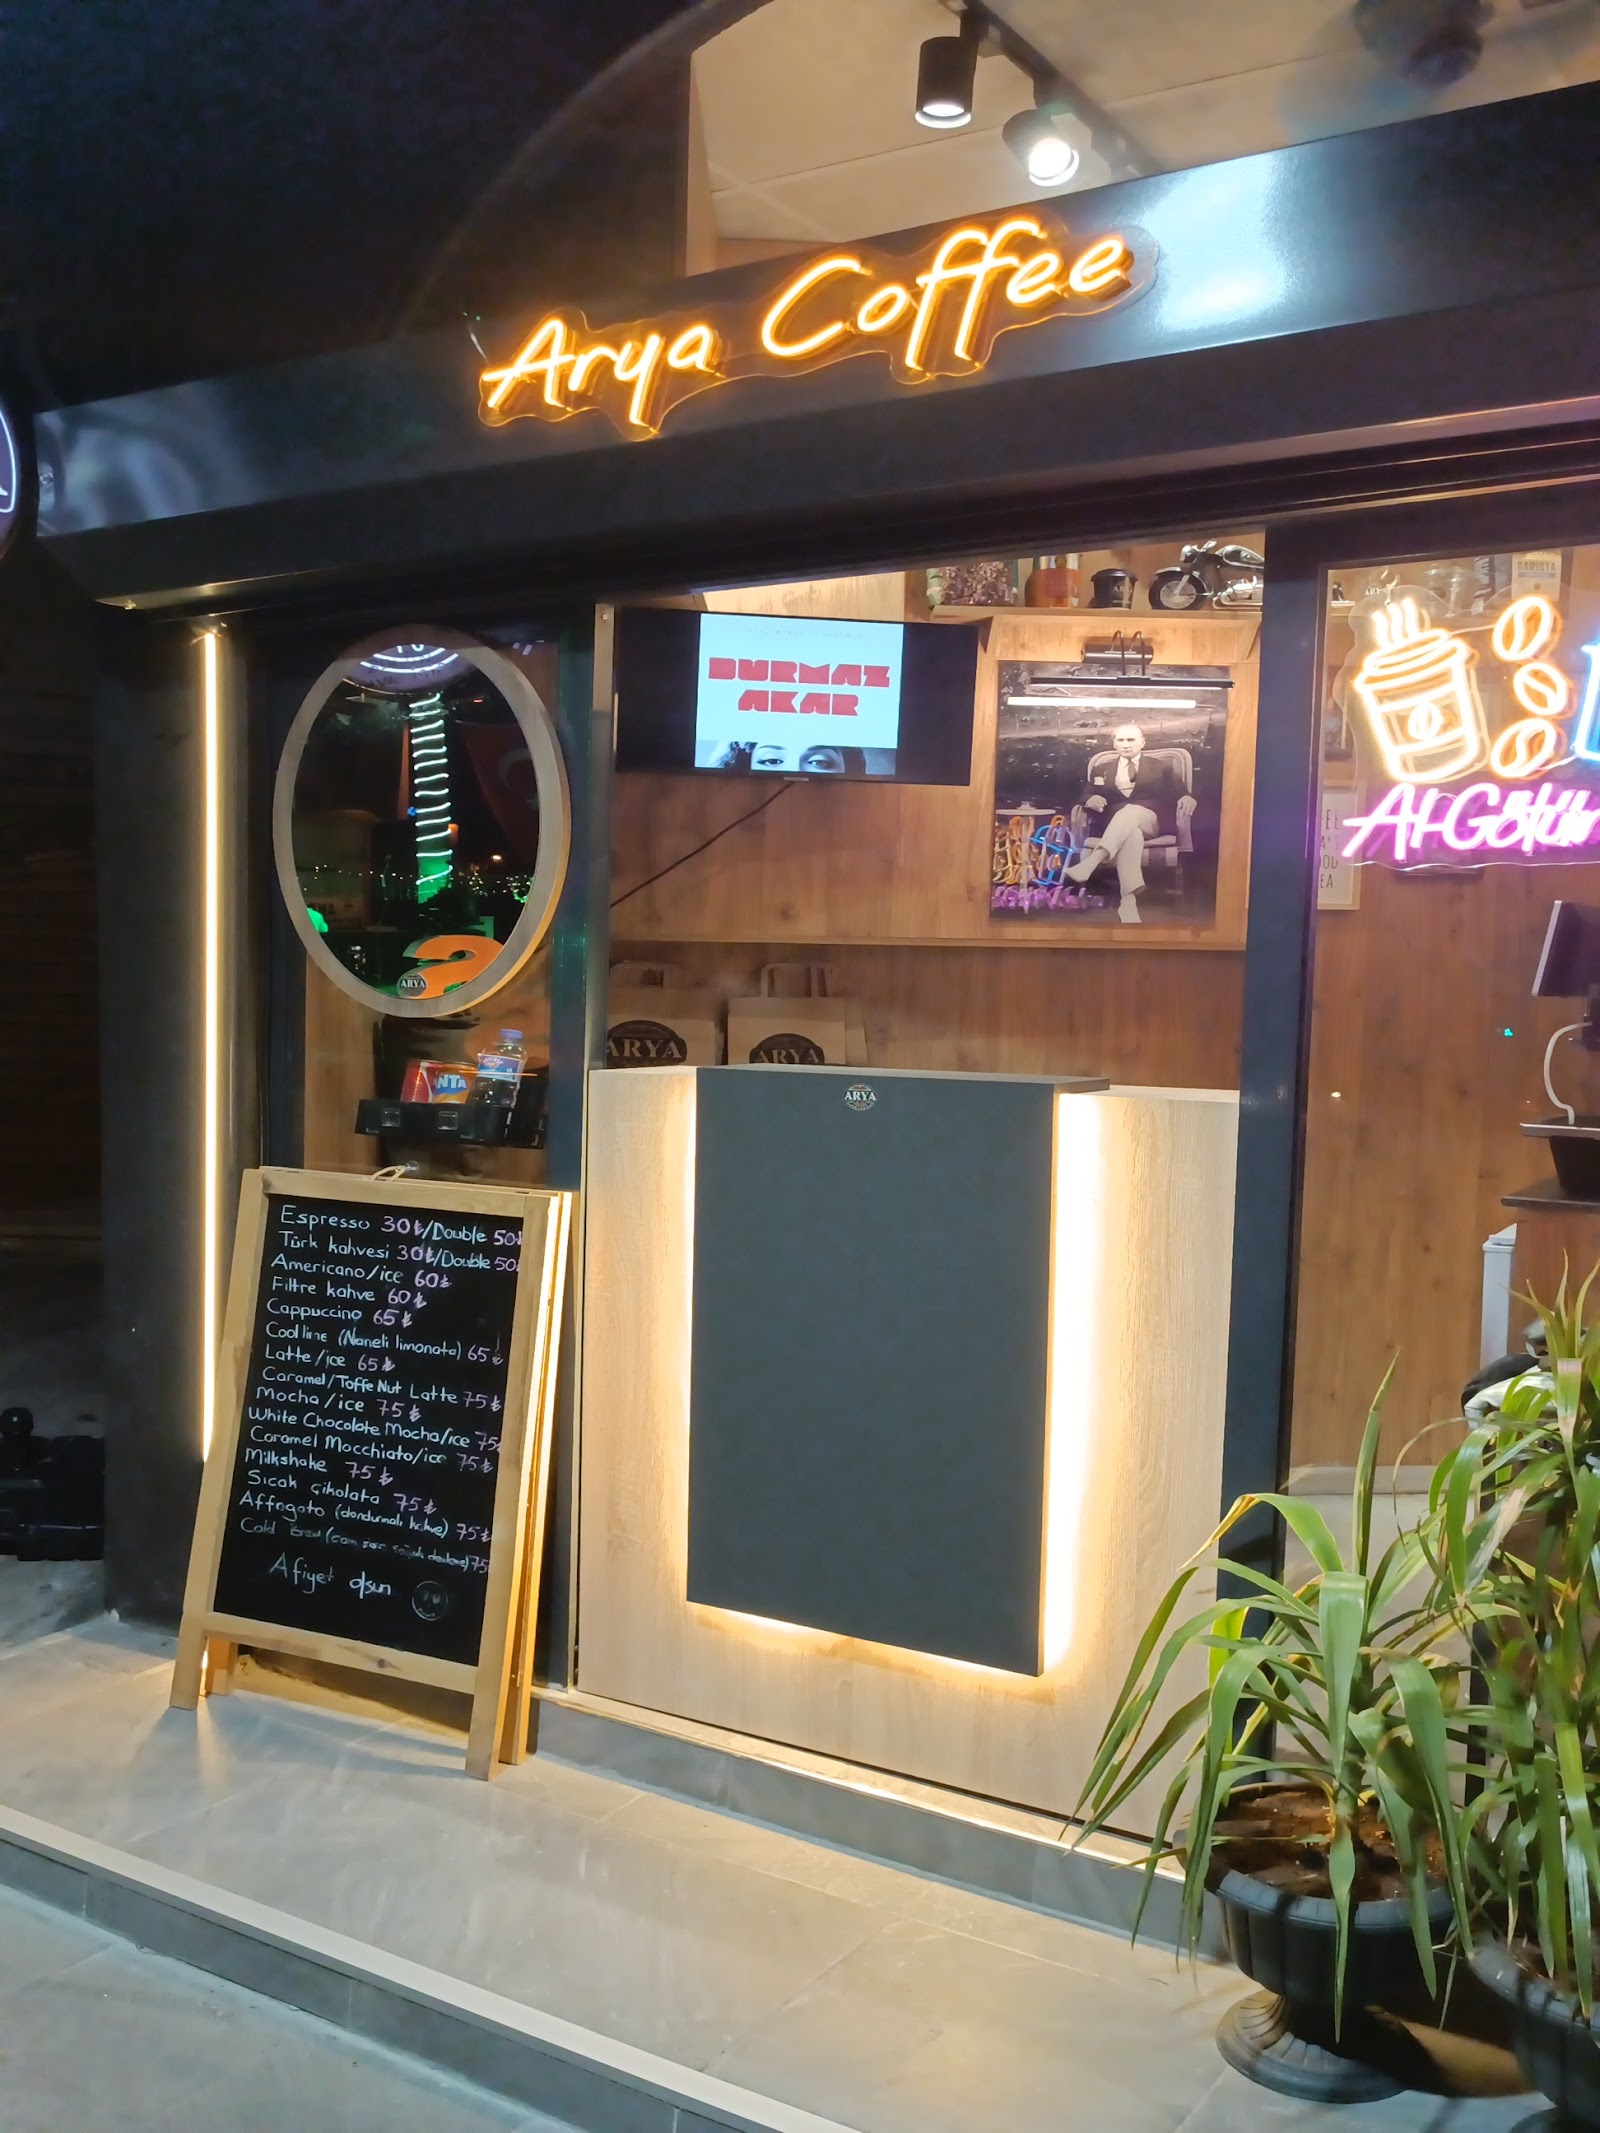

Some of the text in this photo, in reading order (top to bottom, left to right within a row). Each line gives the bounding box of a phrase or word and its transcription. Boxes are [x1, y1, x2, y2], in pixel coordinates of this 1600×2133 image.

[481, 216, 1133, 432] Arya Coffee
[1517, 561, 1556, 572] BARISTA
[708, 657, 890, 688] DURMAZ
[738, 689, 859, 717] AKAR
[400, 979, 426, 989] ARYA
[606, 1038, 682, 1058] ARYA
[756, 1048, 819, 1064] ARYA
[844, 1090, 877, 1102] ARYA
[279, 1204, 371, 1231] Espresso
[278, 1230, 319, 1249] Türk
[327, 1235, 390, 1260] kahvesi
[272, 1275, 317, 1295] Filtre
[326, 1280, 375, 1301] kahve
[266, 1297, 363, 1321] Cappuccino
[395, 1333, 461, 1361] limonata)
[377, 1378, 403, 1395] Nut
[409, 1383, 459, 1404] Latte
[248, 1406, 298, 1425] White
[302, 1411, 381, 1436] Chocolate
[244, 1446, 328, 1472] Milkshake
[240, 1517, 276, 1535] Cold
[269, 1551, 391, 1600] Afiyet olsun
